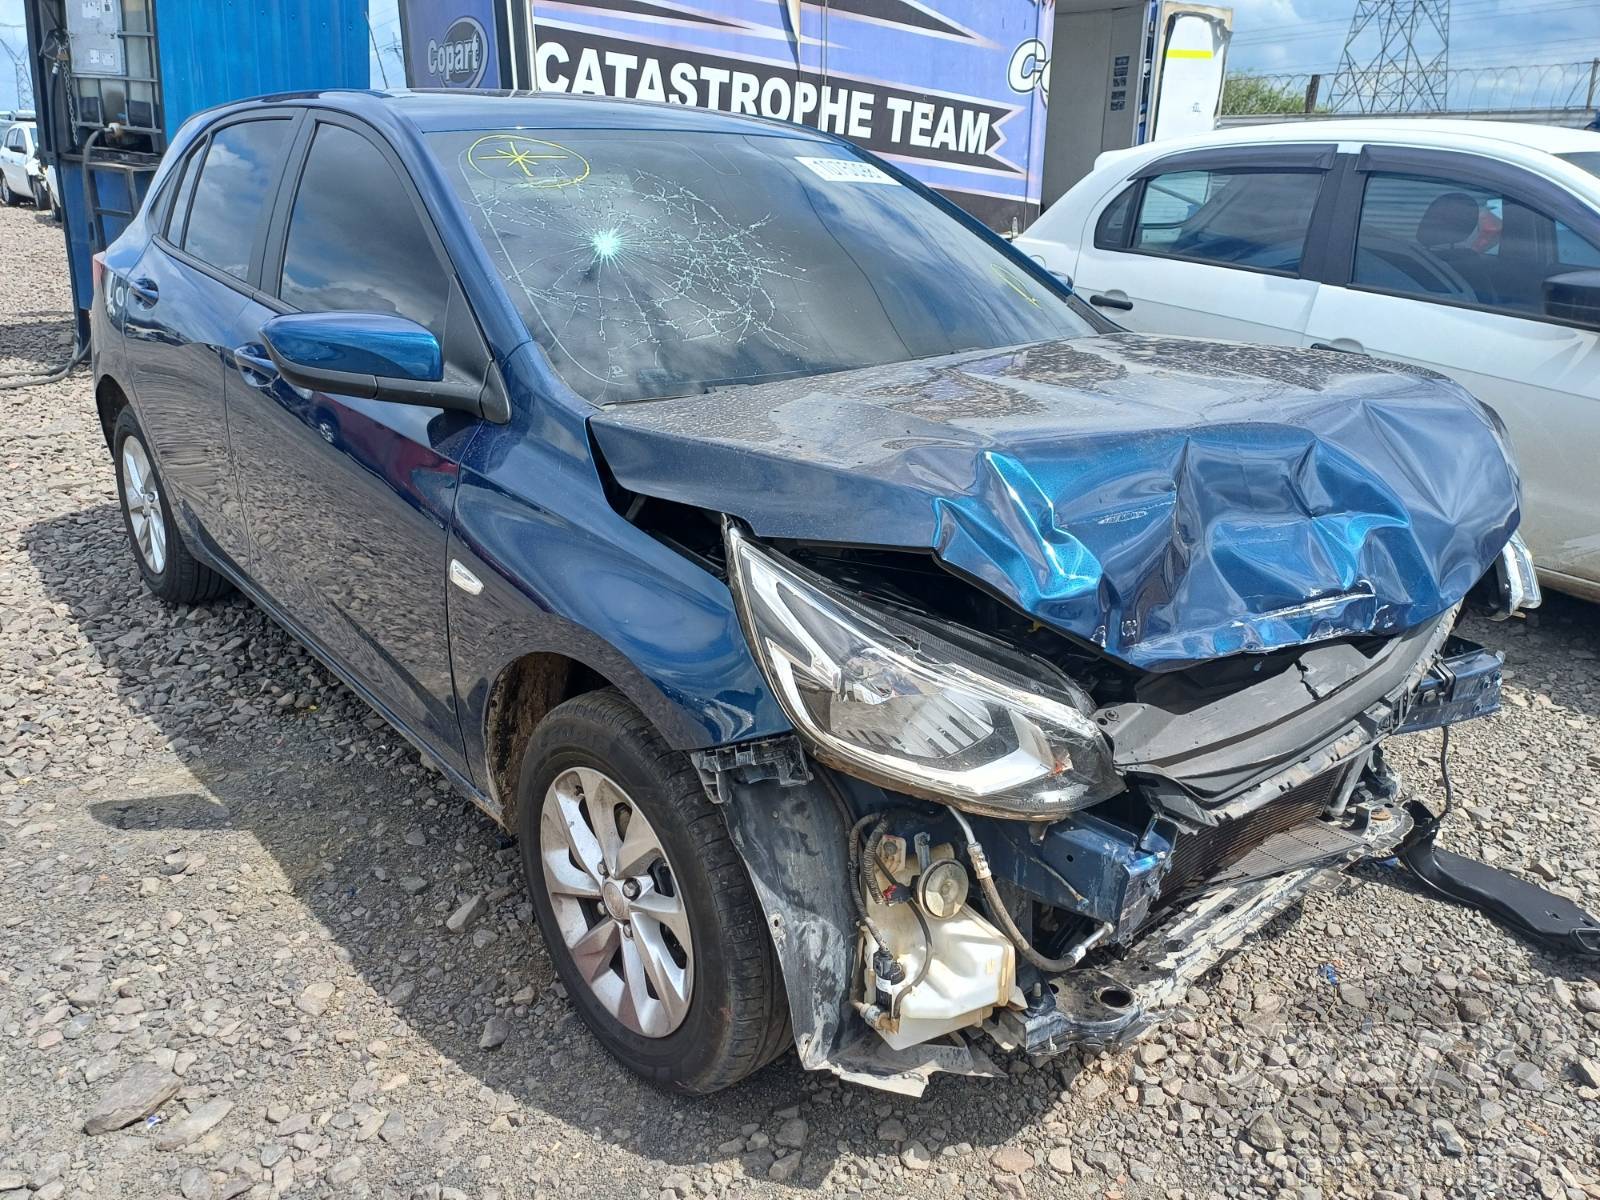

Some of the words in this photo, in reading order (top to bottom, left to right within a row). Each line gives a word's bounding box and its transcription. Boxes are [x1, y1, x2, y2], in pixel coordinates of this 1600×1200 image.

[427, 33, 479, 81] Copart
[536, 41, 875, 139] CATASTROPHE
[887, 97, 990, 155] TEAM
